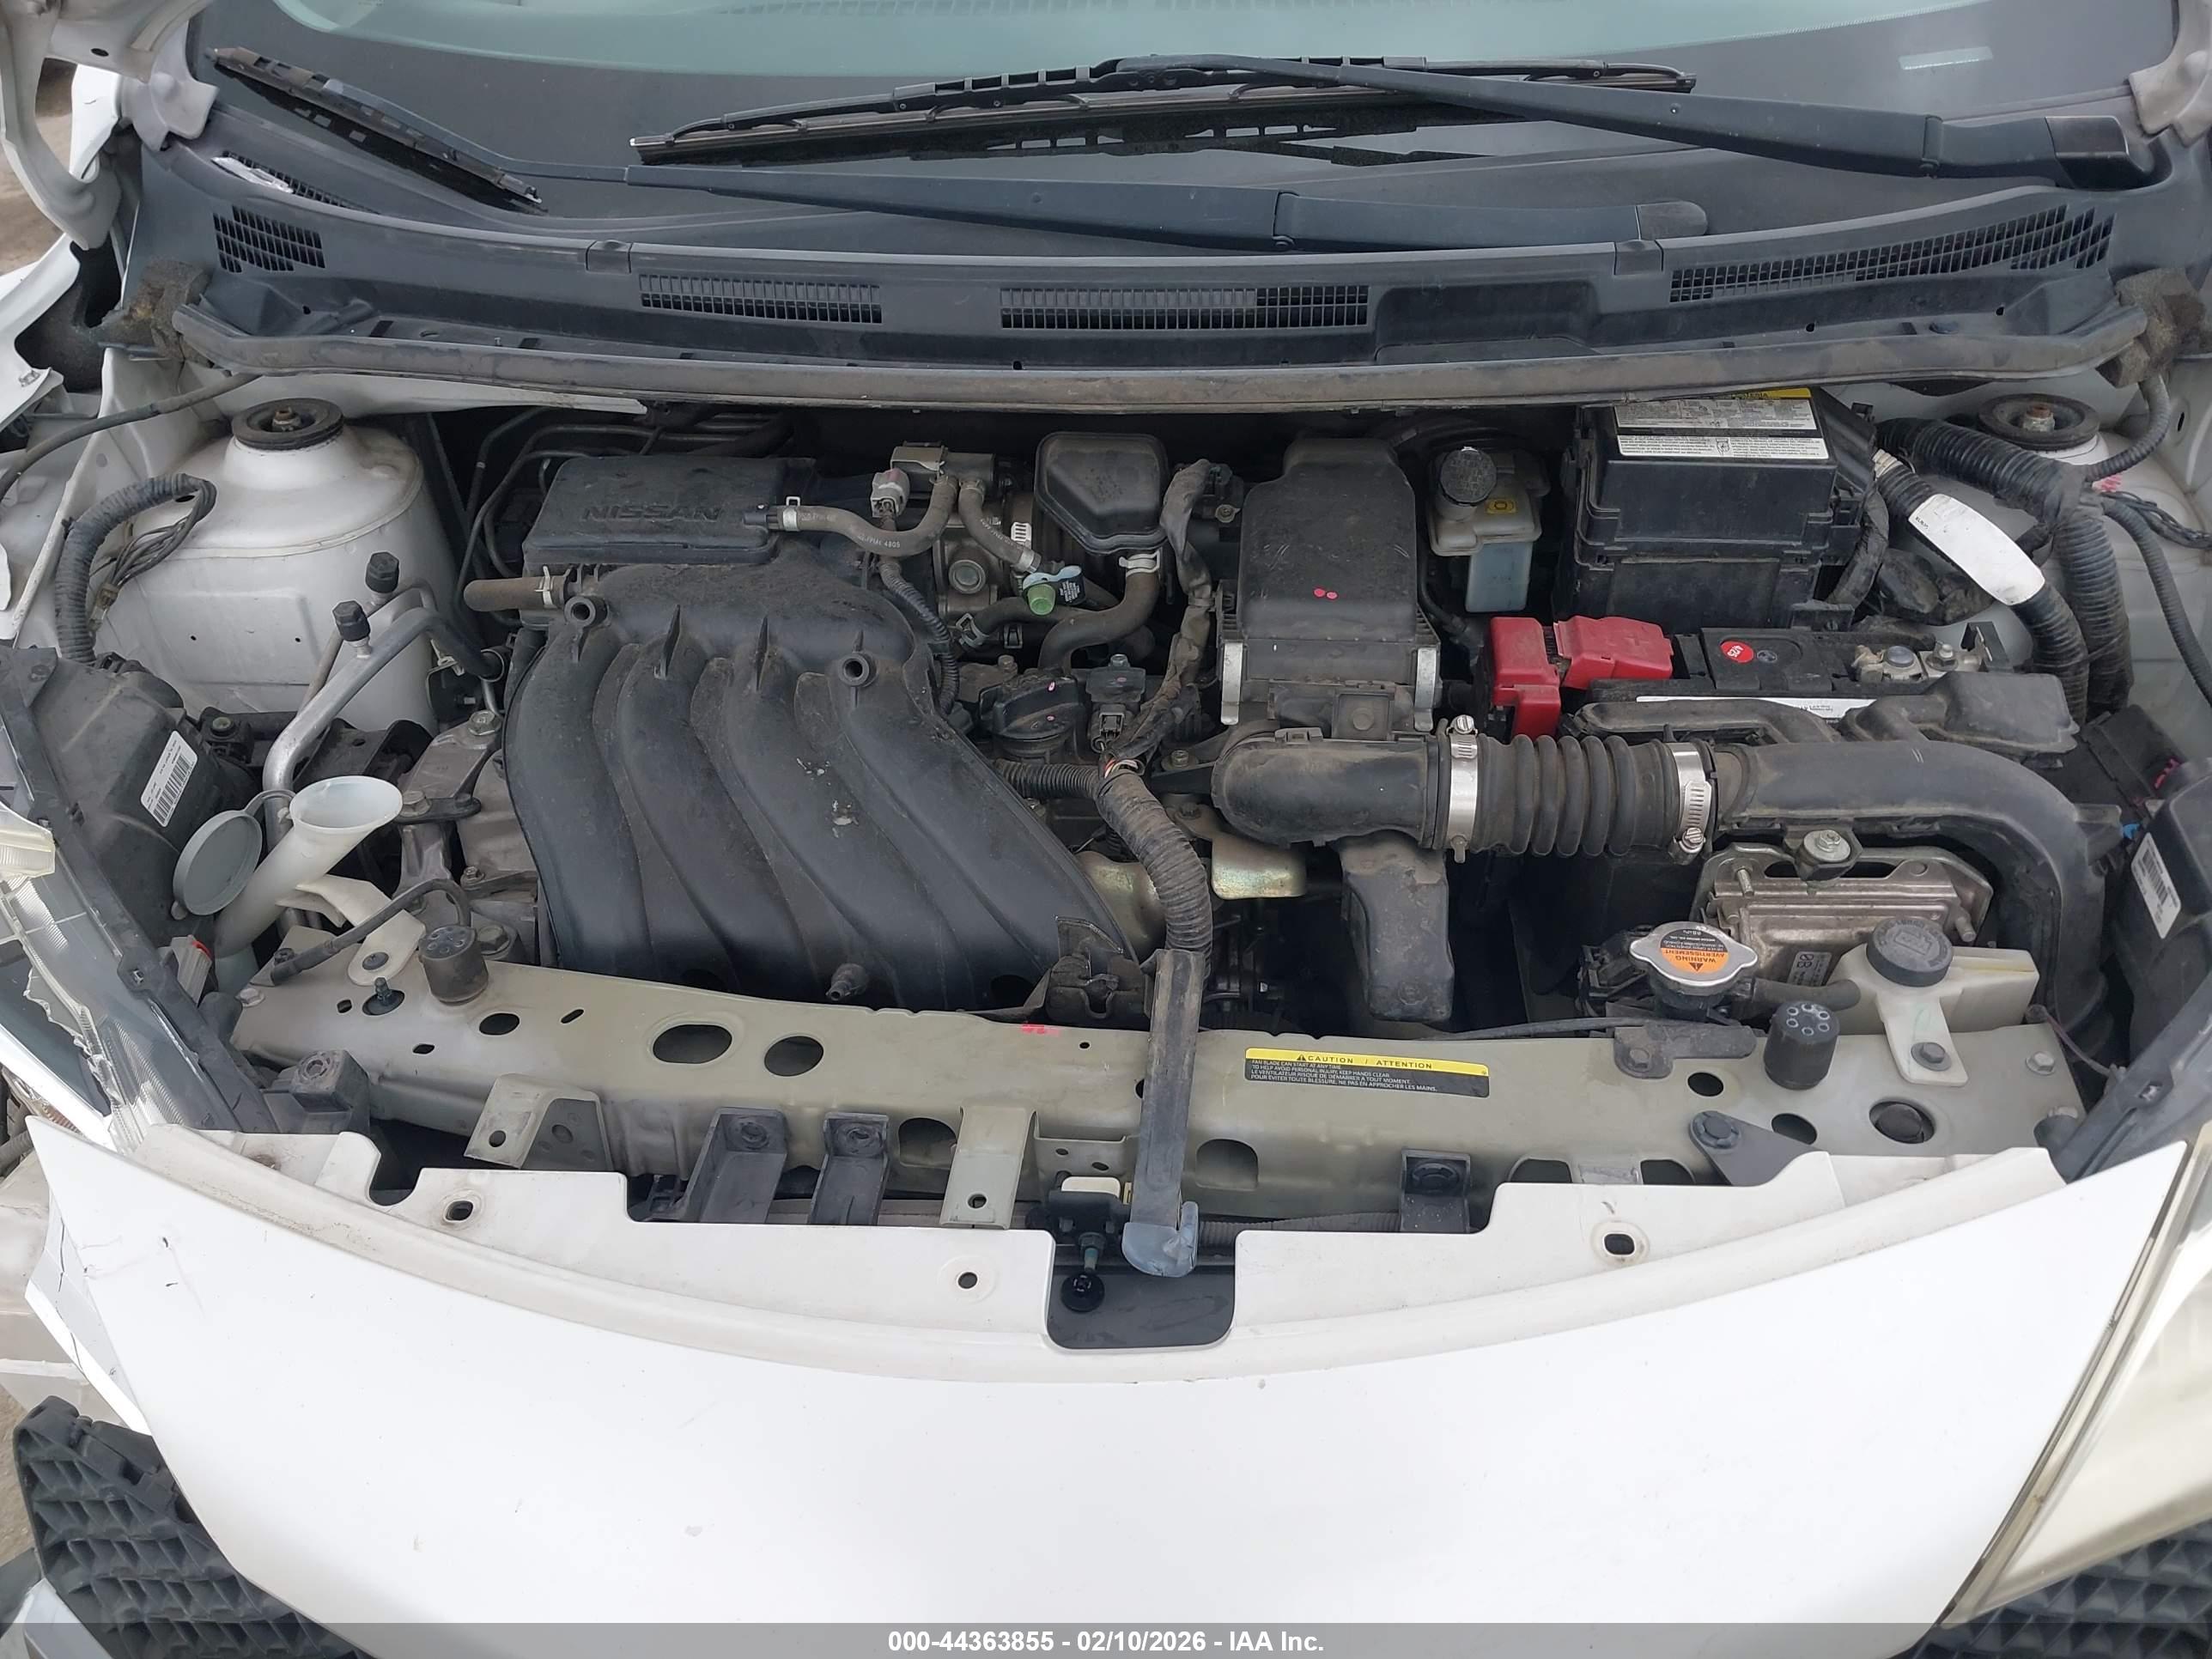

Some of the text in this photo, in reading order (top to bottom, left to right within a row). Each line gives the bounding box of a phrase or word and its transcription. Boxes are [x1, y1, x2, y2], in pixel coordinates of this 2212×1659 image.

[581, 505, 723, 522] NISSAN
[1664, 949, 1725, 957] AVERTISSEMENT
[1308, 1055, 1353, 1064] CAUTION
[1376, 1060, 1432, 1069] ATTENTION
